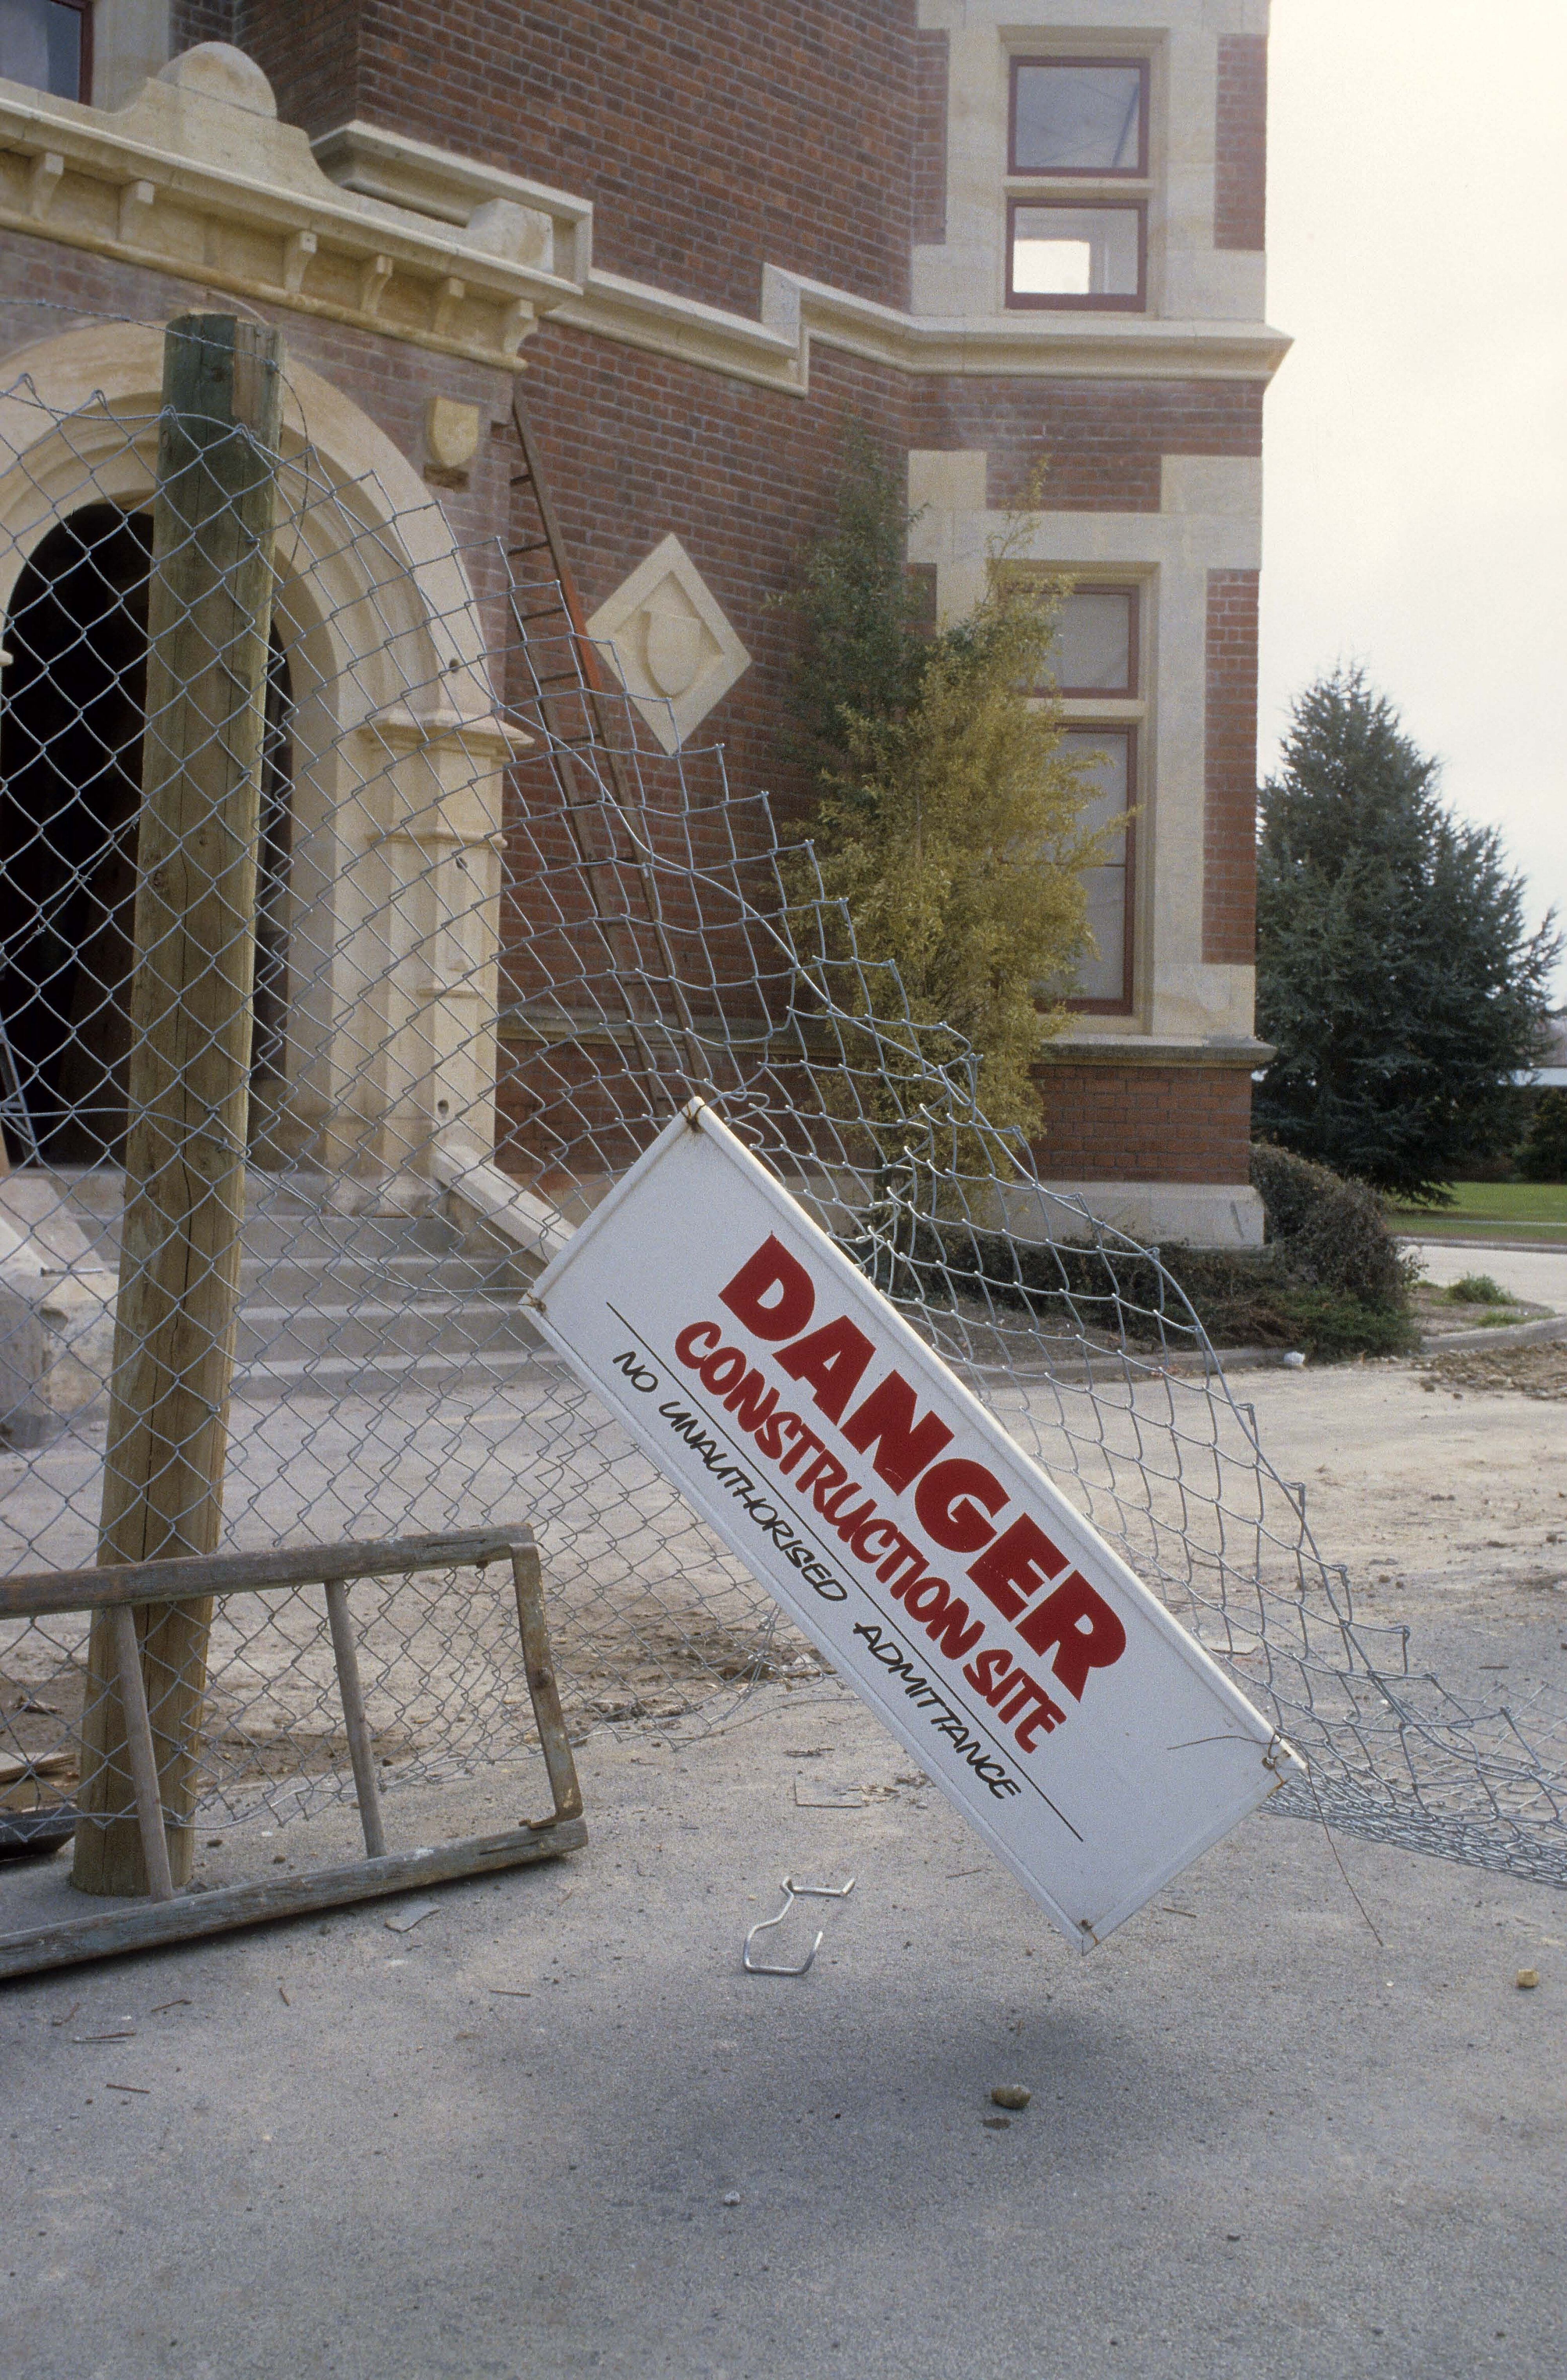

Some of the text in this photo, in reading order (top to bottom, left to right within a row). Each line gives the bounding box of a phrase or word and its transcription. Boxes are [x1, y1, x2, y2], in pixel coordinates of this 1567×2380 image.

[612, 1351, 1022, 1799] NO UNAUTHORISED ADMITTANCE
[675, 1321, 1066, 1753] CONSTRUCTION SITE
[719, 1233, 1127, 1702] DANGER
